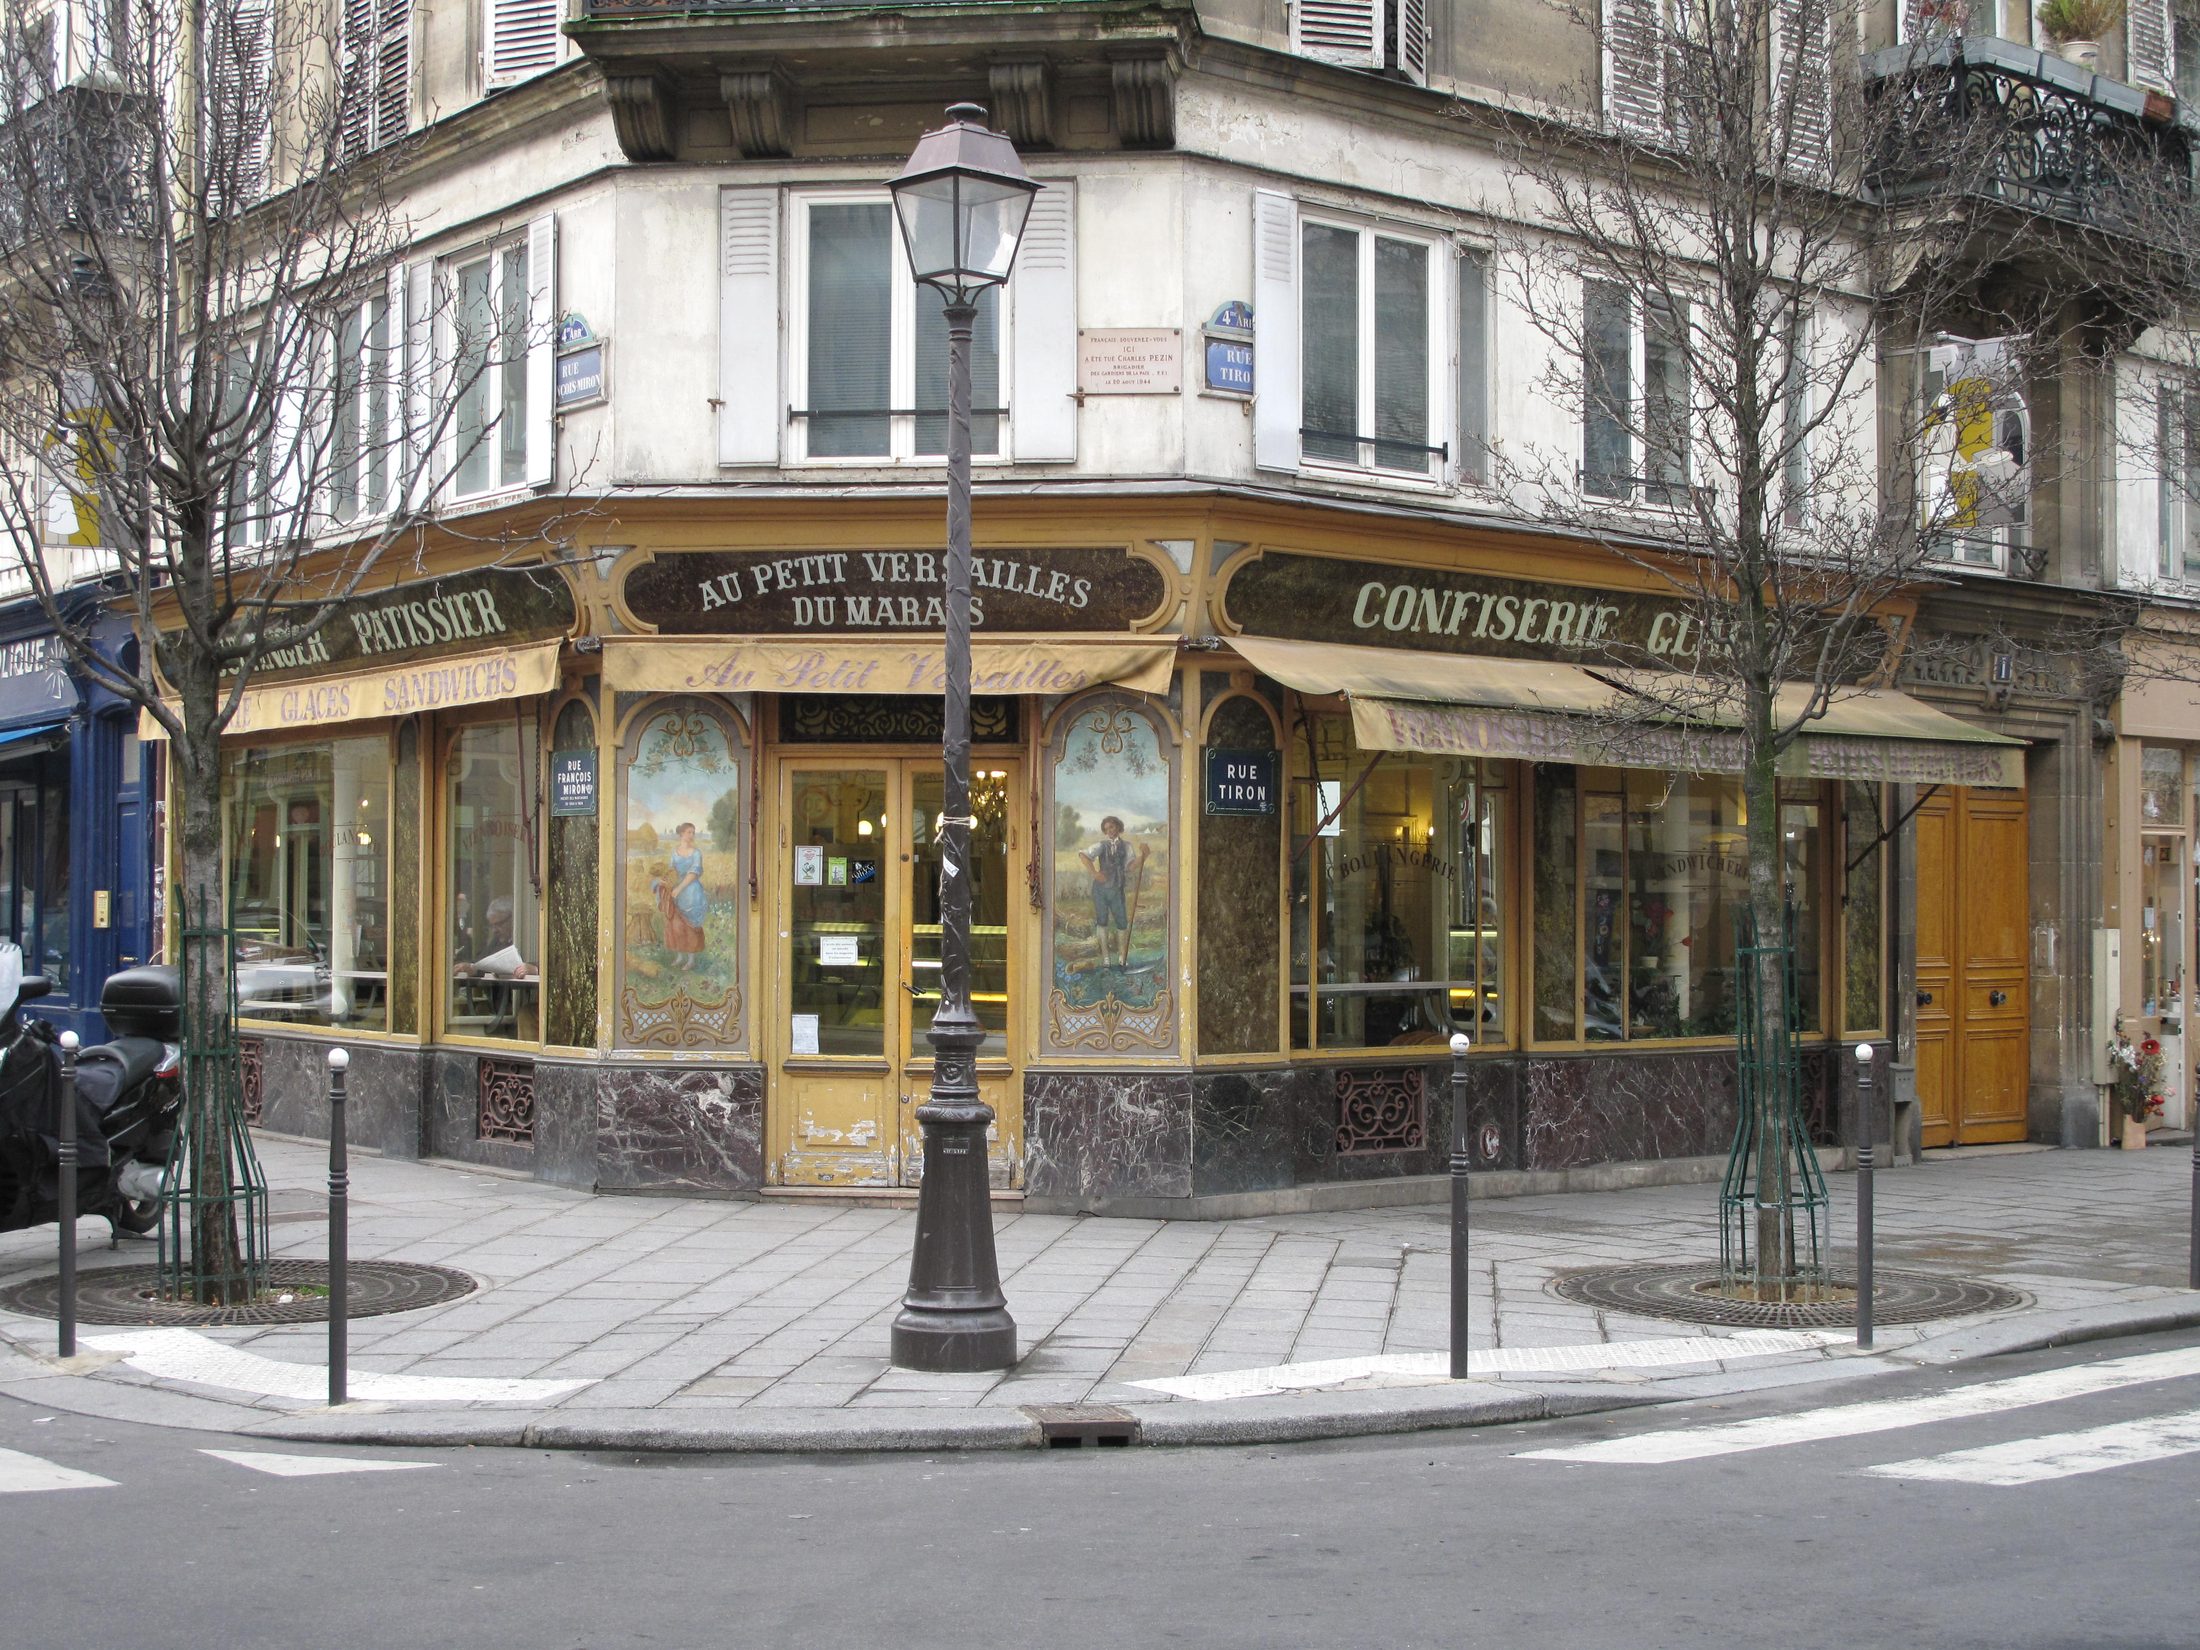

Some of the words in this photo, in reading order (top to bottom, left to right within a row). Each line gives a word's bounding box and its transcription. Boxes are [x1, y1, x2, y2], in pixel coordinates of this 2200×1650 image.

[1149, 354, 1173, 362] PEZIN
[1227, 350, 1253, 366] RUE
[562, 362, 579, 378] RUE
[699, 571, 745, 612] AU
[751, 553, 848, 595] PETIT
[861, 551, 1092, 609] VERAILLES
[792, 596, 836, 626] DU
[844, 596, 985, 627] MARAS
[1352, 581, 1620, 649] CONFISERIE
[0, 638, 46, 679] LIQUE
[686, 648, 755, 690] Au
[775, 649, 880, 691] Petit
[901, 650, 1090, 691] Vesailles
[280, 685, 350, 724] GLACES
[384, 656, 517, 712] SANDWICHS
[567, 760, 581, 771] RUE
[1227, 764, 1257, 779] RUE
[557, 771, 592, 784] FRANÇOIS
[563, 784, 586, 795] MIRON
[1219, 785, 1266, 801] TIRON
